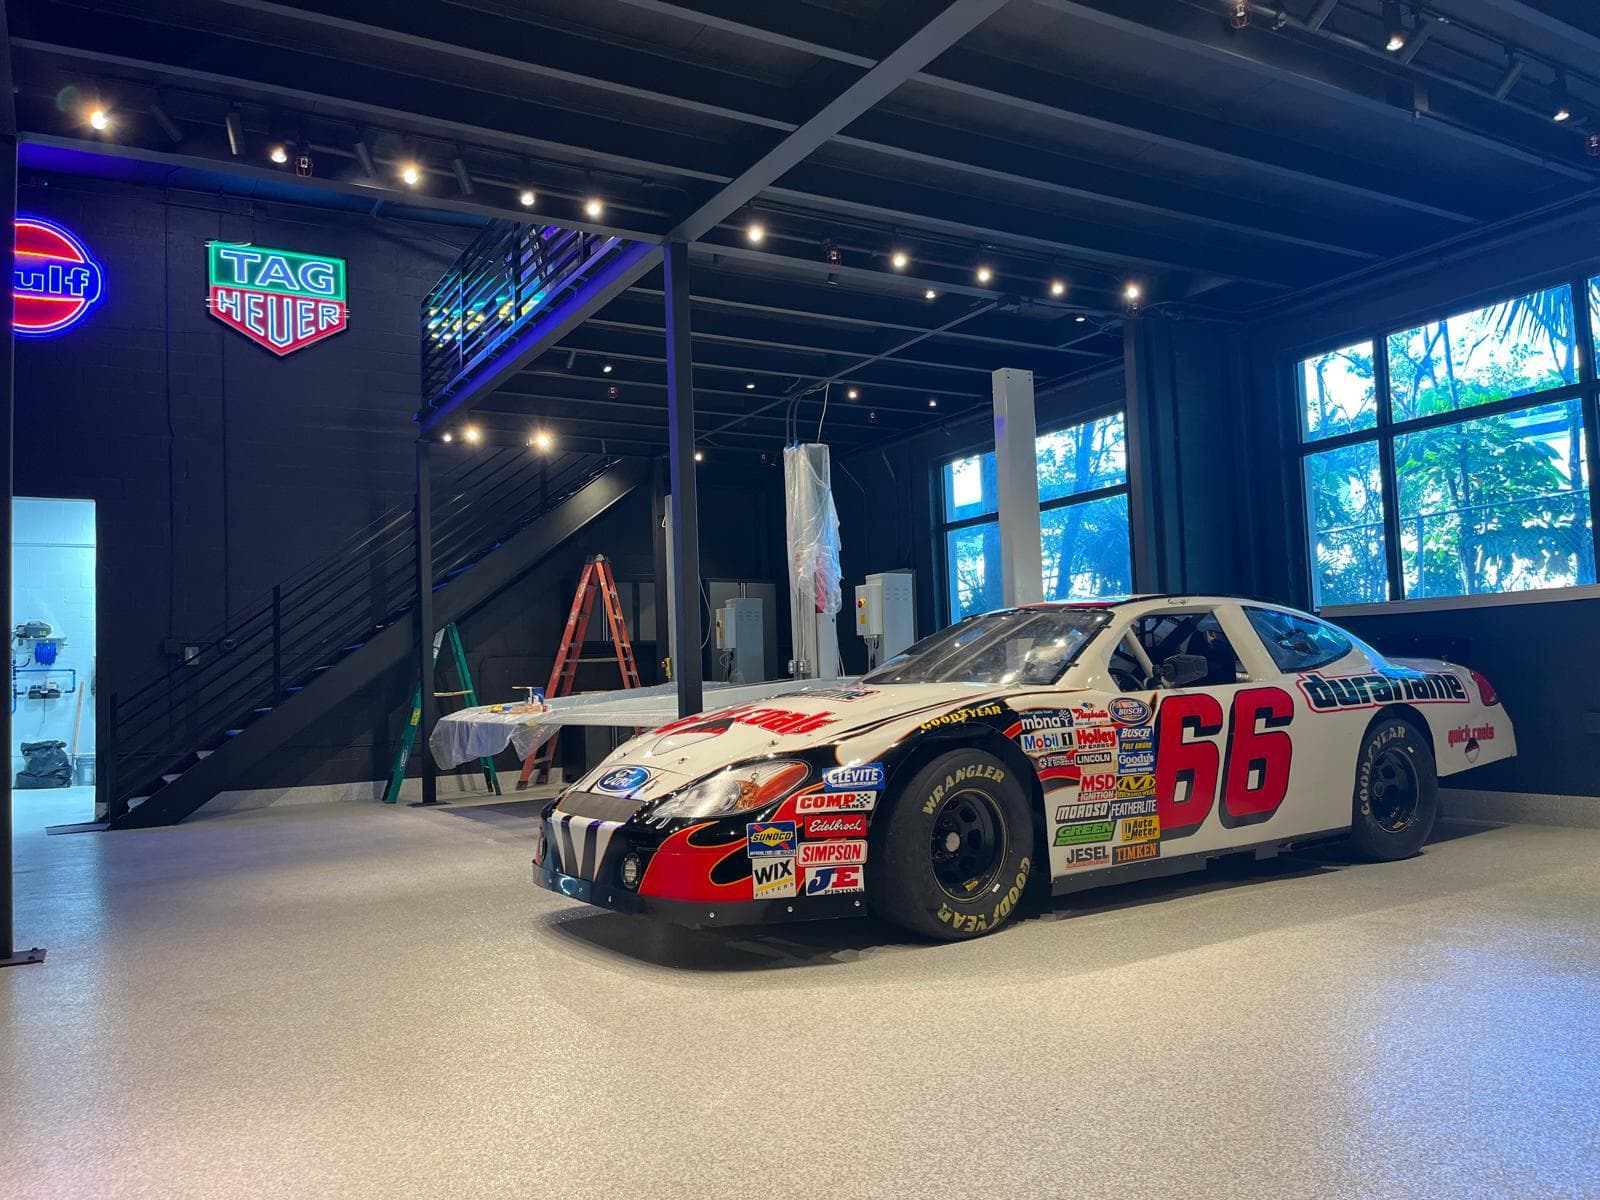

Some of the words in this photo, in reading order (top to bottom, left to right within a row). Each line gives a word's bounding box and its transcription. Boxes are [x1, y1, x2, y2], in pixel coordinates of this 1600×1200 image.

[221, 249, 335, 294] TAG
[14, 265, 90, 297] ulf
[217, 290, 339, 348] HEUER
[1118, 707, 1143, 717] BUSCH
[1021, 715, 1061, 730] mbna
[1024, 733, 1059, 750] Mobil
[1076, 729, 1116, 748] Holley
[1120, 728, 1151, 739] BUSCH
[1077, 753, 1111, 765] LINCOLN
[1154, 686, 1294, 830] 66
[603, 769, 642, 787] Ford
[828, 768, 878, 784] CLEVITE
[1081, 774, 1117, 791] MSD
[922, 764, 1006, 816] WRANGLER
[1080, 791, 1115, 801] IGNITION
[800, 794, 857, 809] COMP
[1112, 801, 1157, 816] FEATHERLITE
[1056, 804, 1109, 820] MOROSO
[809, 819, 862, 832] Edelbrock
[1058, 823, 1114, 837] GREEN
[1132, 827, 1158, 837] Meter
[1134, 819, 1153, 829] Auto
[752, 832, 792, 842] SUNOCO
[802, 844, 862, 862] SIMPSON
[1066, 846, 1110, 864] JESEL
[1116, 843, 1157, 862] TIMKEN
[754, 859, 793, 885] WIX
[807, 866, 860, 894] JE
[755, 882, 794, 898] FILTERS
